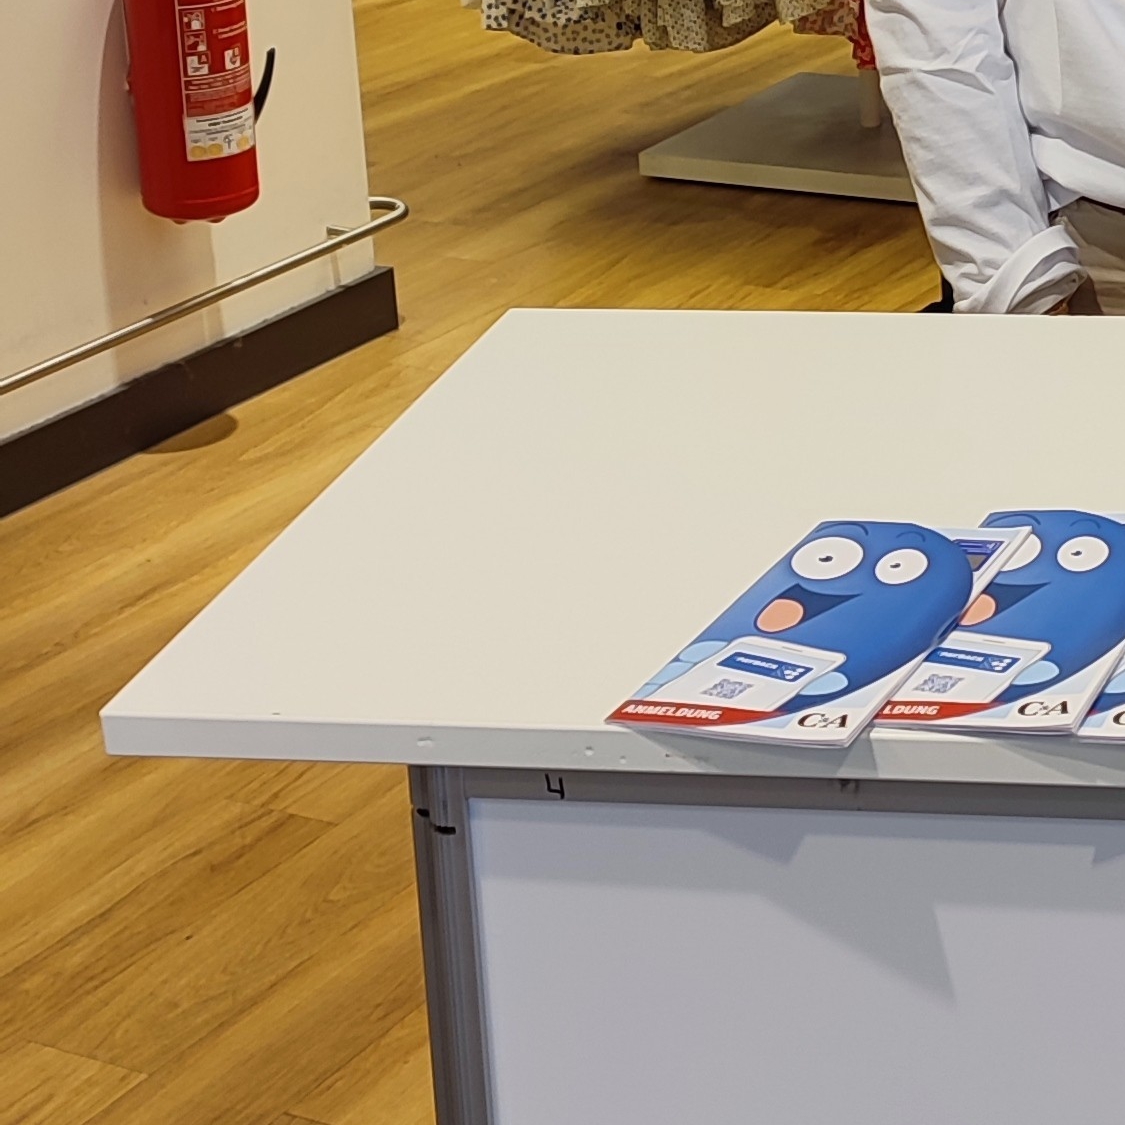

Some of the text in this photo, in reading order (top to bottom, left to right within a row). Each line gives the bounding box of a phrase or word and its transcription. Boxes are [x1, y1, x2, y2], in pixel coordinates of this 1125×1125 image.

[735, 656, 778, 670] PAYBACK
[621, 703, 723, 721] ANMELDUNG
[1017, 700, 1070, 717] C&A
[797, 712, 849, 729] C&A
[544, 773, 565, 800] 4
